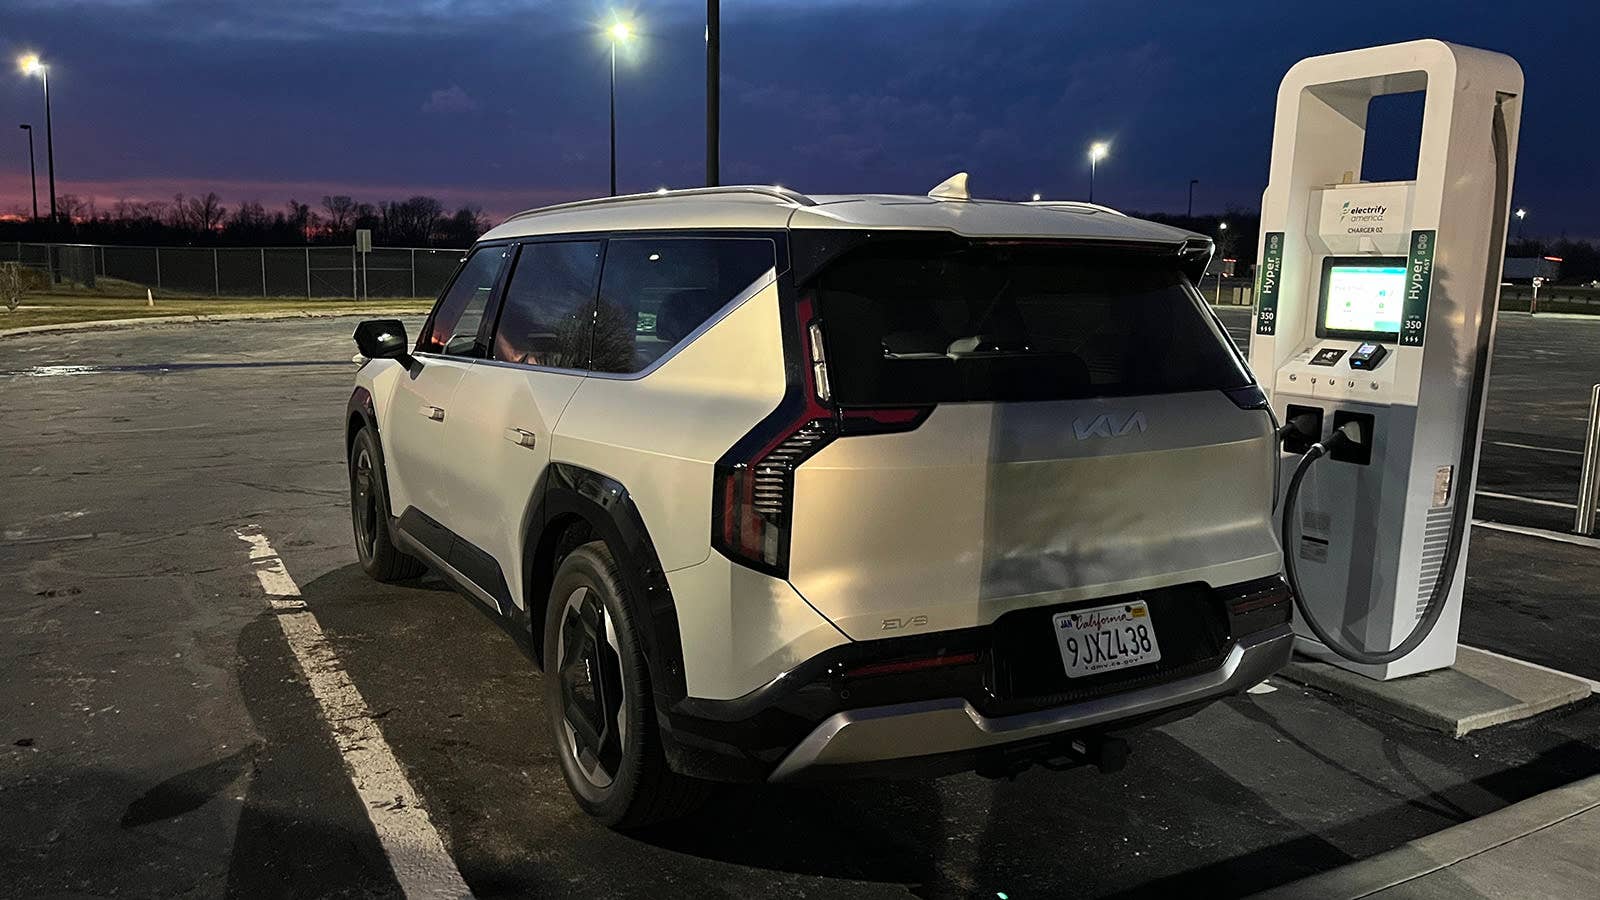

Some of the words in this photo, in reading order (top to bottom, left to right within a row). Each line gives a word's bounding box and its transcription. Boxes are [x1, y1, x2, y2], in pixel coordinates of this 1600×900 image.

[1350, 205, 1387, 215] electrify
[1347, 226, 1375, 234] CHARGER
[1263, 257, 1275, 294] Hyper
[1408, 258, 1424, 300] Hyper
[1260, 312, 1274, 320] 350
[1404, 320, 1422, 330] 350
[881, 614, 928, 632] EV9
[1060, 619, 1073, 629] JAN
[1075, 612, 1133, 631] California
[1066, 624, 1152, 667] 9JXZ438
